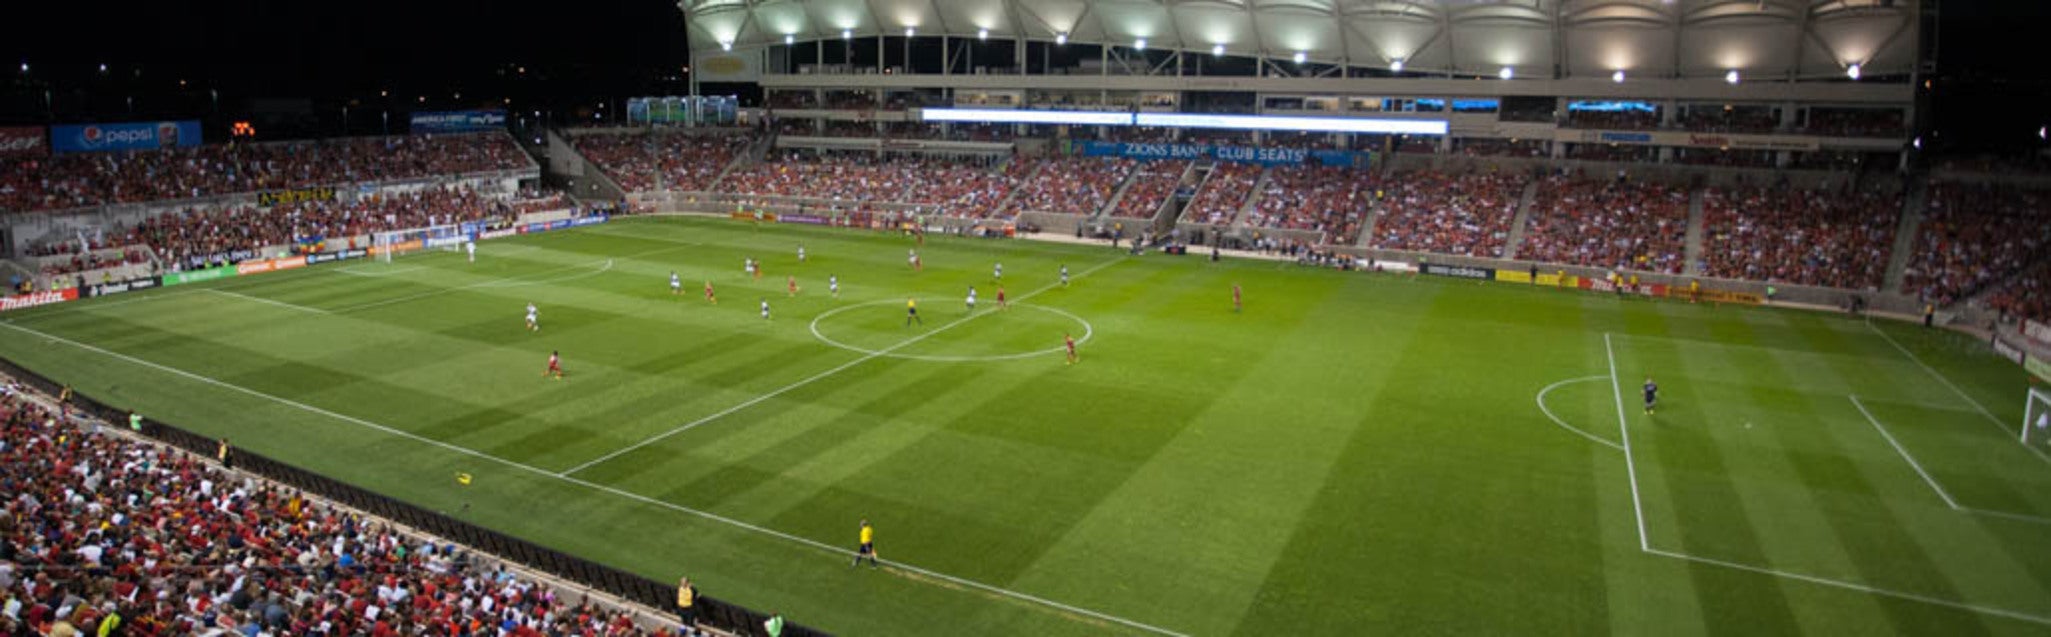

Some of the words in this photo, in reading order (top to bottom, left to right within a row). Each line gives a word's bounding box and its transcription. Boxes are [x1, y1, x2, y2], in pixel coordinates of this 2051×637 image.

[106, 127, 152, 143] pepsi
[1125, 143, 1167, 155] ZIONS
[1217, 147, 1254, 160] CLUB
[1258, 149, 1304, 162] SEATS
